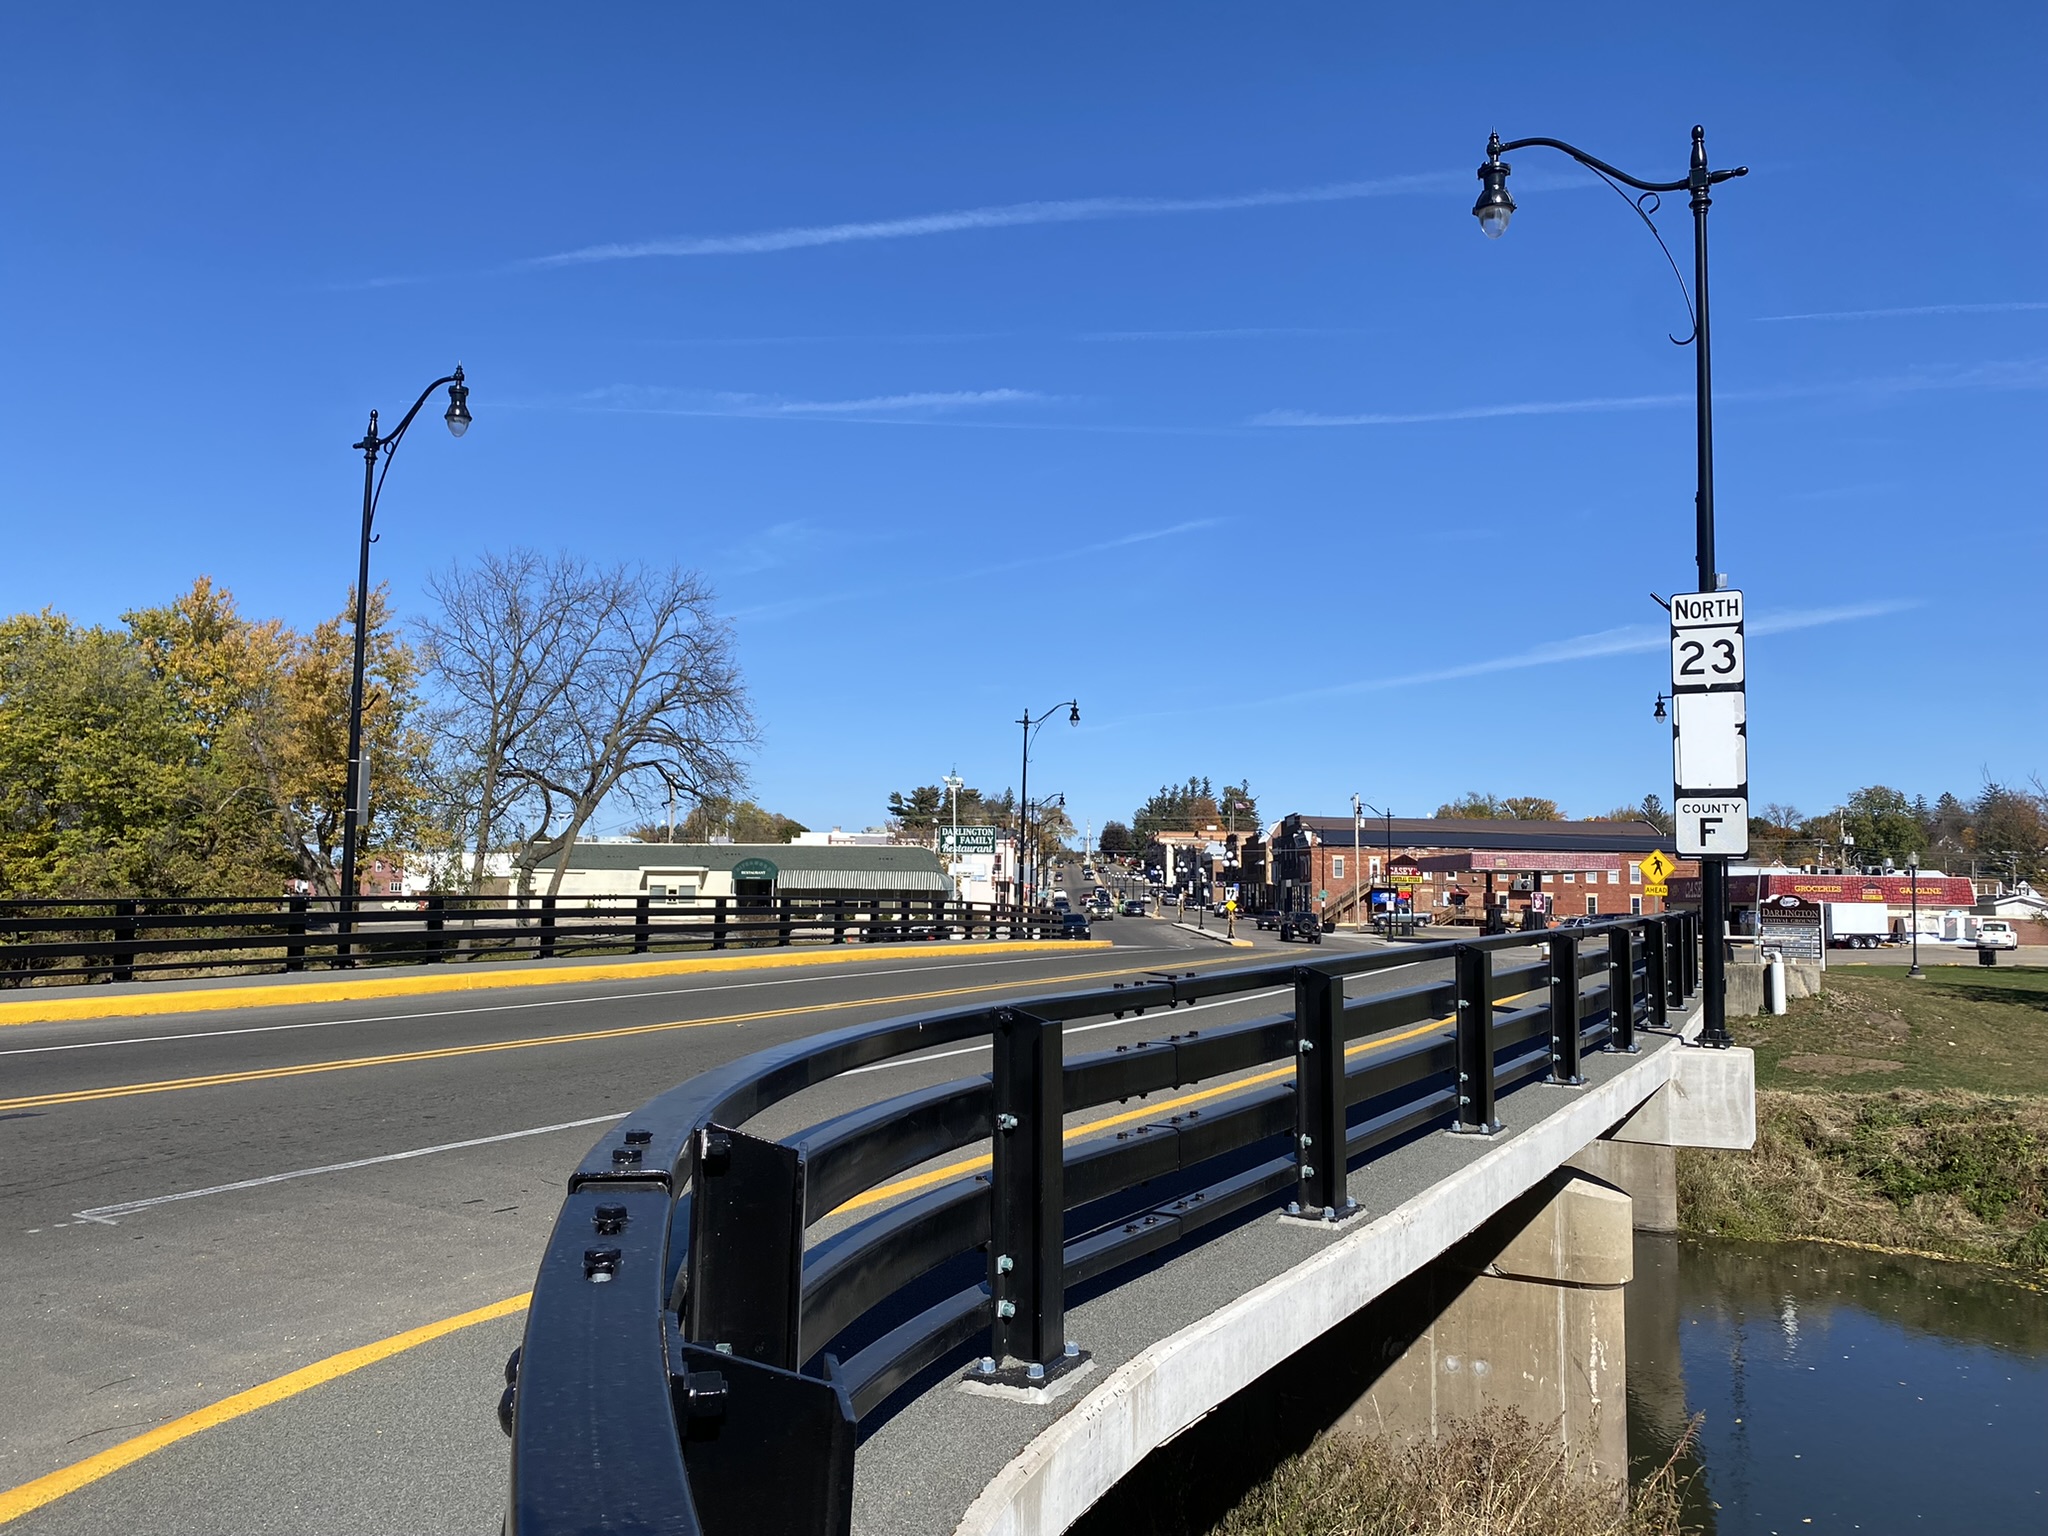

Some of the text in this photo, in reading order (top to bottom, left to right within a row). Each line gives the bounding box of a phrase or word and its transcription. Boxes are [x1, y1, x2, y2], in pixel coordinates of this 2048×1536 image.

[1674, 599, 1739, 620] NORTH
[1680, 638, 1737, 676] 23
[1682, 804, 1742, 814] COUNTY
[1699, 818, 1723, 846] F
[1646, 886, 1667, 894] AHEAD
[1794, 885, 1841, 893] GROCERIES
[1899, 887, 1942, 895] GAOLINE
[1762, 908, 1819, 918] DARLINGTON
